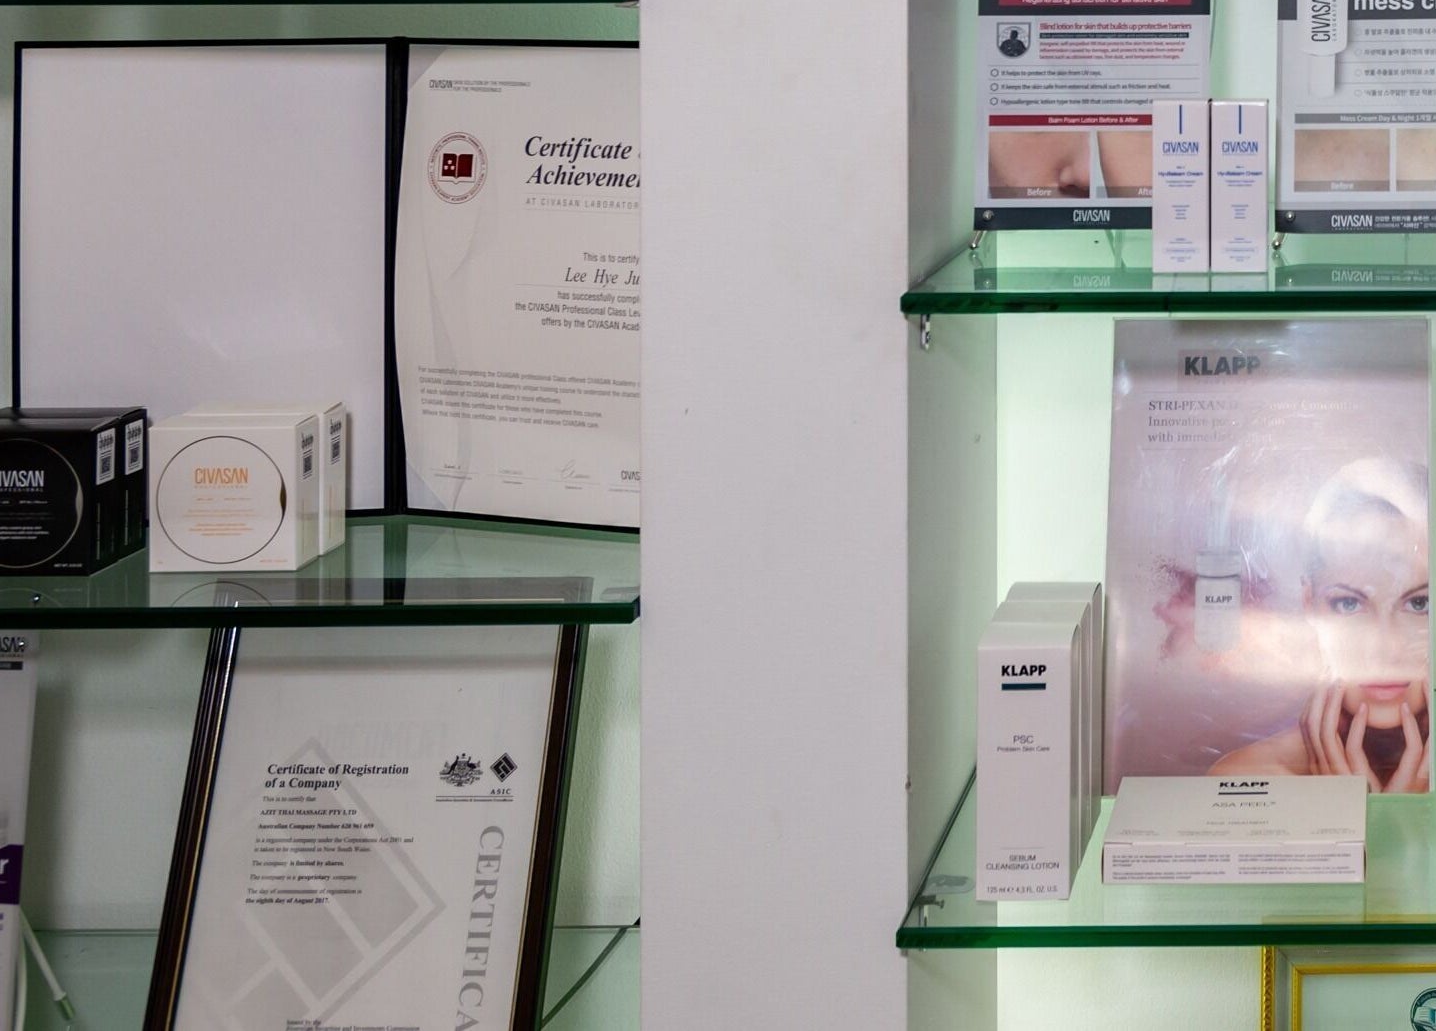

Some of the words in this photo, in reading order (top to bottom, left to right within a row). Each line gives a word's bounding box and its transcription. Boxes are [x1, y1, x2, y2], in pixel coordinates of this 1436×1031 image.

[525, 136, 632, 163] Certificate
[1162, 142, 1199, 154] CIVASAN
[1222, 142, 1258, 154] CIVASAN
[526, 165, 640, 188] Achieveme
[1027, 188, 1052, 196] Before
[541, 198, 580, 207] CIVASAN
[1073, 210, 1110, 222] CIVASAN
[1331, 215, 1373, 227] CIVASAN
[565, 267, 587, 283] Lee
[593, 269, 619, 288] Hye
[515, 302, 526, 311] the
[528, 303, 560, 313] CIVASAN
[562, 304, 606, 316] Professional
[607, 307, 626, 317] Class
[1184, 356, 1261, 376] KLAPP
[0, 470, 44, 488] IVASAN
[194, 468, 248, 485] CIVASAN
[1205, 595, 1232, 603] KLAPP
[1001, 664, 1047, 677] KLAPP
[1013, 735, 1034, 744] PSC
[268, 764, 325, 775] Certificate
[329, 764, 340, 775] of
[342, 764, 409, 776] Registration
[265, 777, 277, 788] of
[289, 778, 342, 790] Company
[1009, 854, 1036, 862] SEBUM
[986, 862, 1029, 871] CLEANSING
[1030, 862, 1059, 870] LOTION
